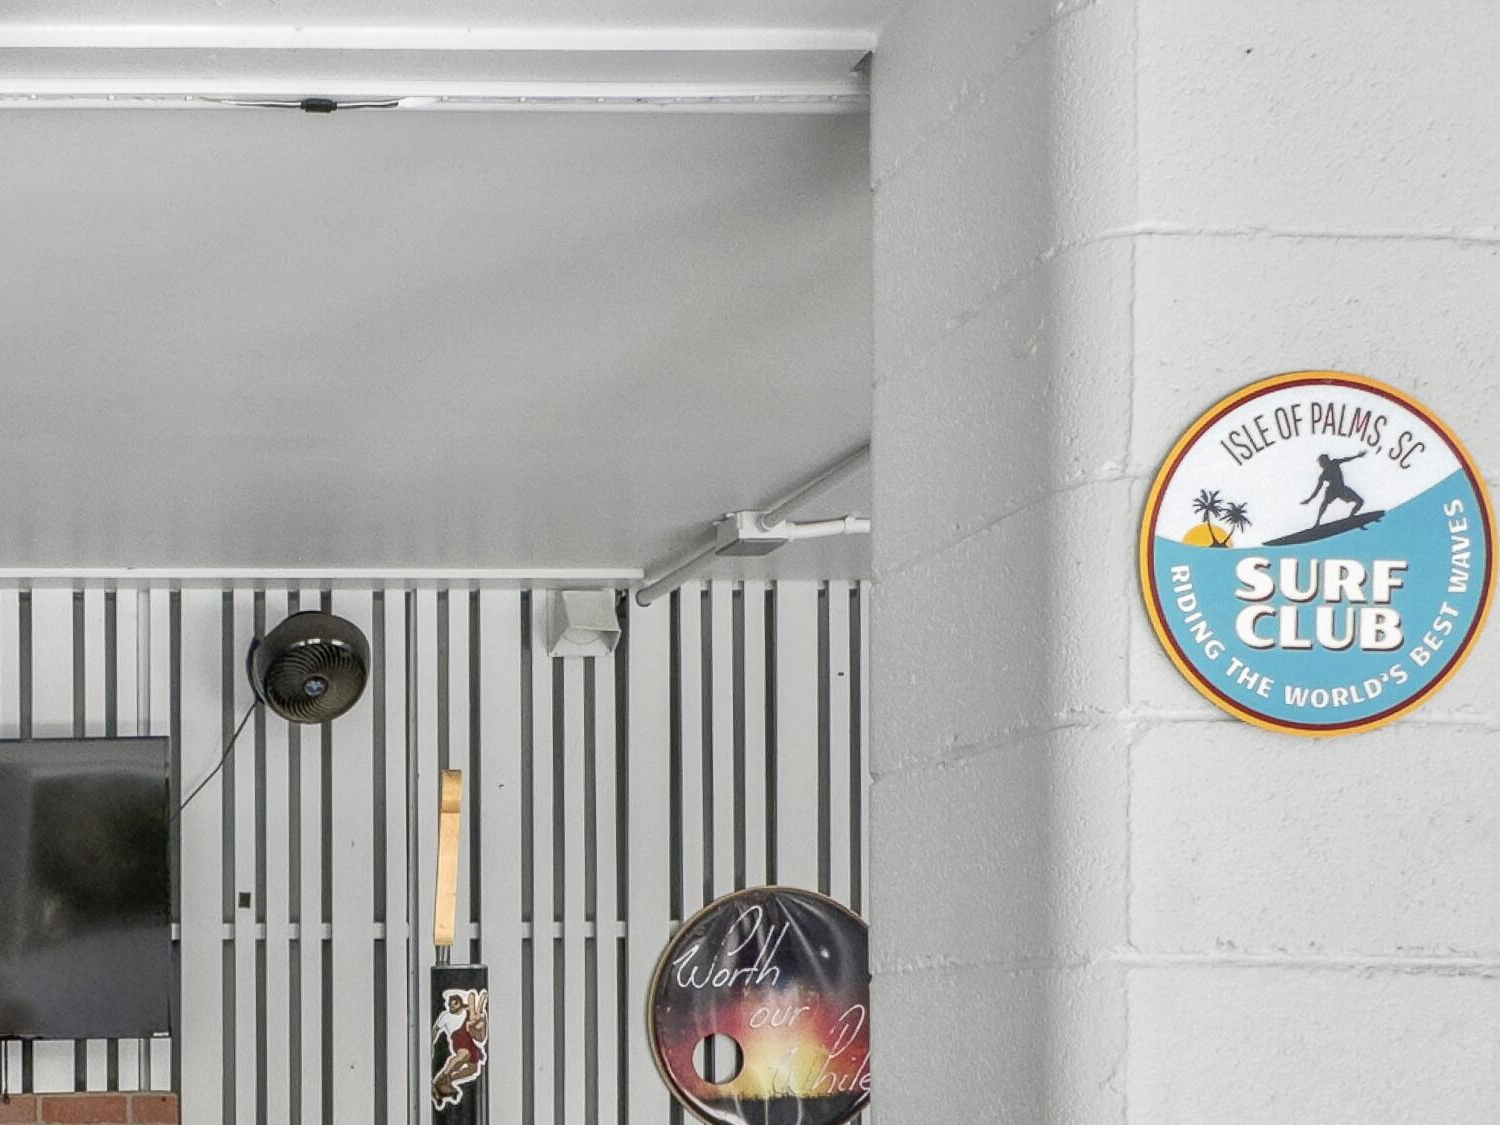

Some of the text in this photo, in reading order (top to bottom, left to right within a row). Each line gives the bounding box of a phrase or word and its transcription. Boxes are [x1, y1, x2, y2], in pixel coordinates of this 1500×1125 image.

[1221, 402, 1426, 470] ISLE OF PALMS, SC
[1170, 499, 1471, 709] RIDING THE WORLD'S BEST WAVES
[1234, 556, 1408, 604] SURF
[1235, 604, 1404, 652] CLUB
[673, 905, 790, 988] Worth
[750, 1004, 811, 1029] our
